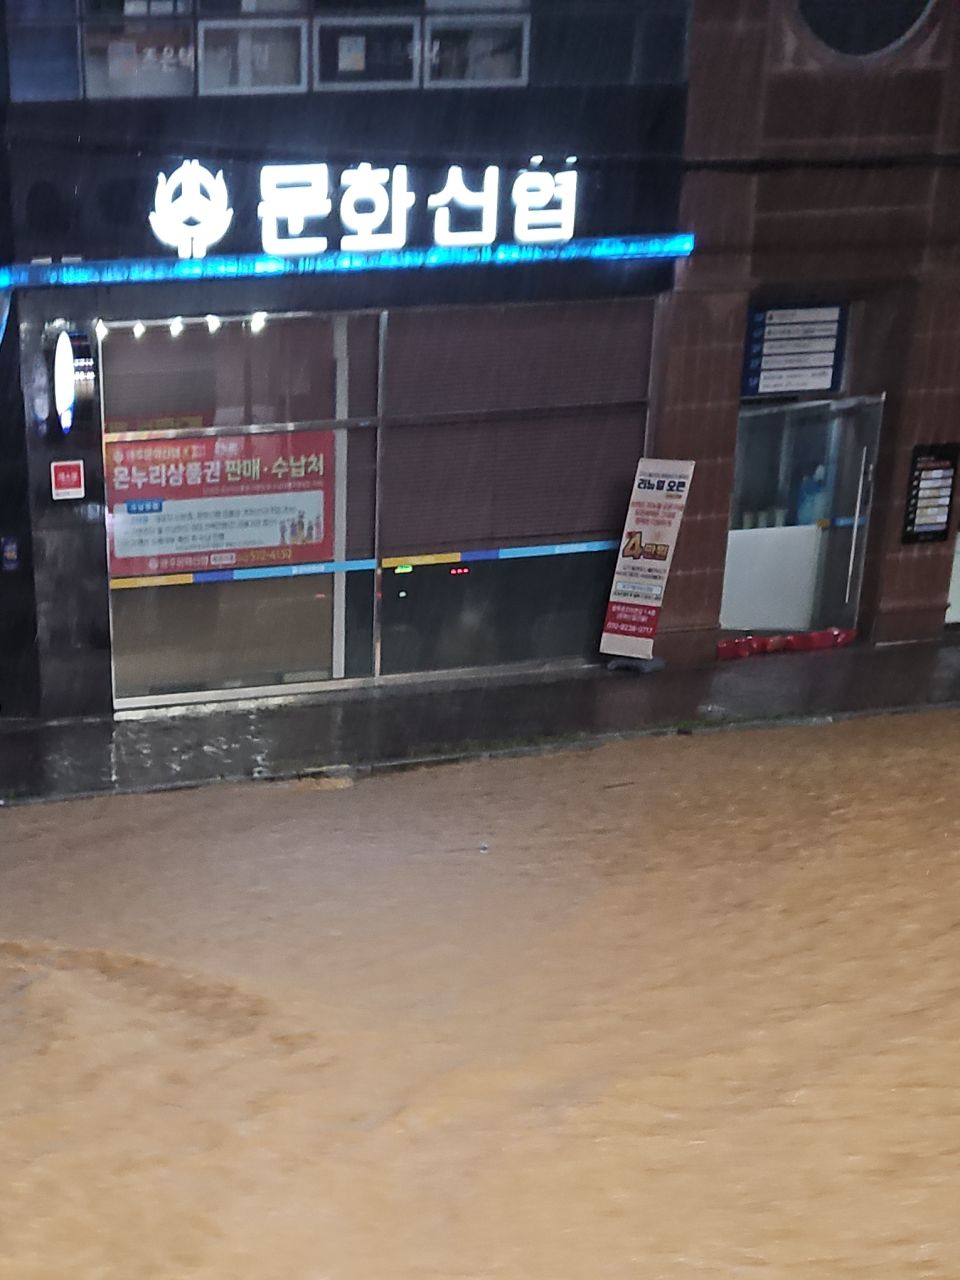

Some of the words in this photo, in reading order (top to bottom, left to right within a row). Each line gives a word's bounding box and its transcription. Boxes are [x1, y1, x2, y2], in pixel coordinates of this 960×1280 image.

[258, 154, 578, 256] 문화신협
[113, 460, 221, 490] 온누리상품권
[637, 478, 665, 491] 리뉴얼
[666, 480, 686, 492] 오픈
